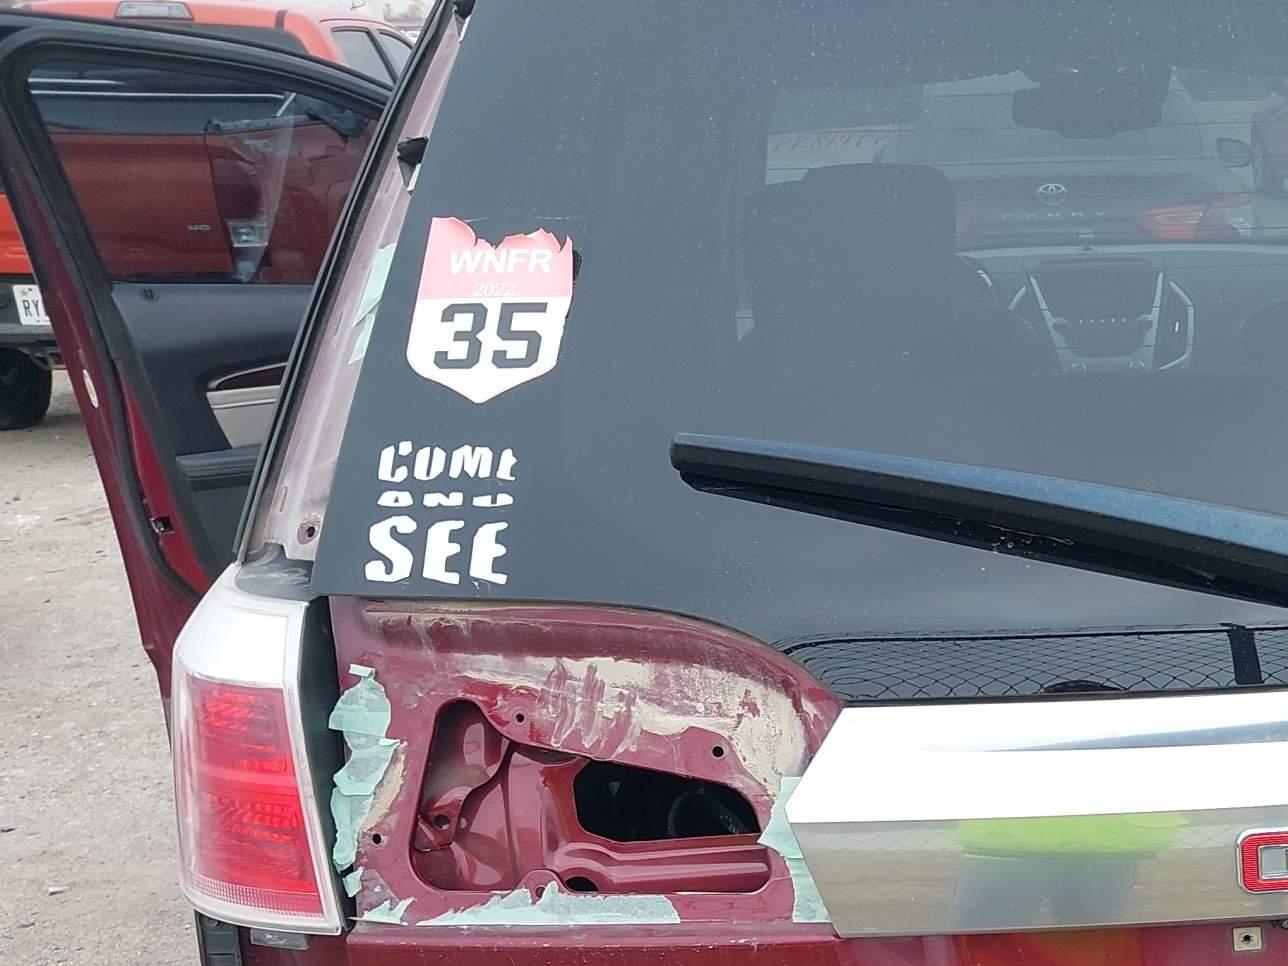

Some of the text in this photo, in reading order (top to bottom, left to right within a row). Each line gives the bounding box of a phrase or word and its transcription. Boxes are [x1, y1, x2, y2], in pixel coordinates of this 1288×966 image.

[449, 248, 554, 275] WNFR
[472, 281, 517, 297] 2022
[433, 302, 549, 370] 35
[364, 515, 509, 585] SEE
